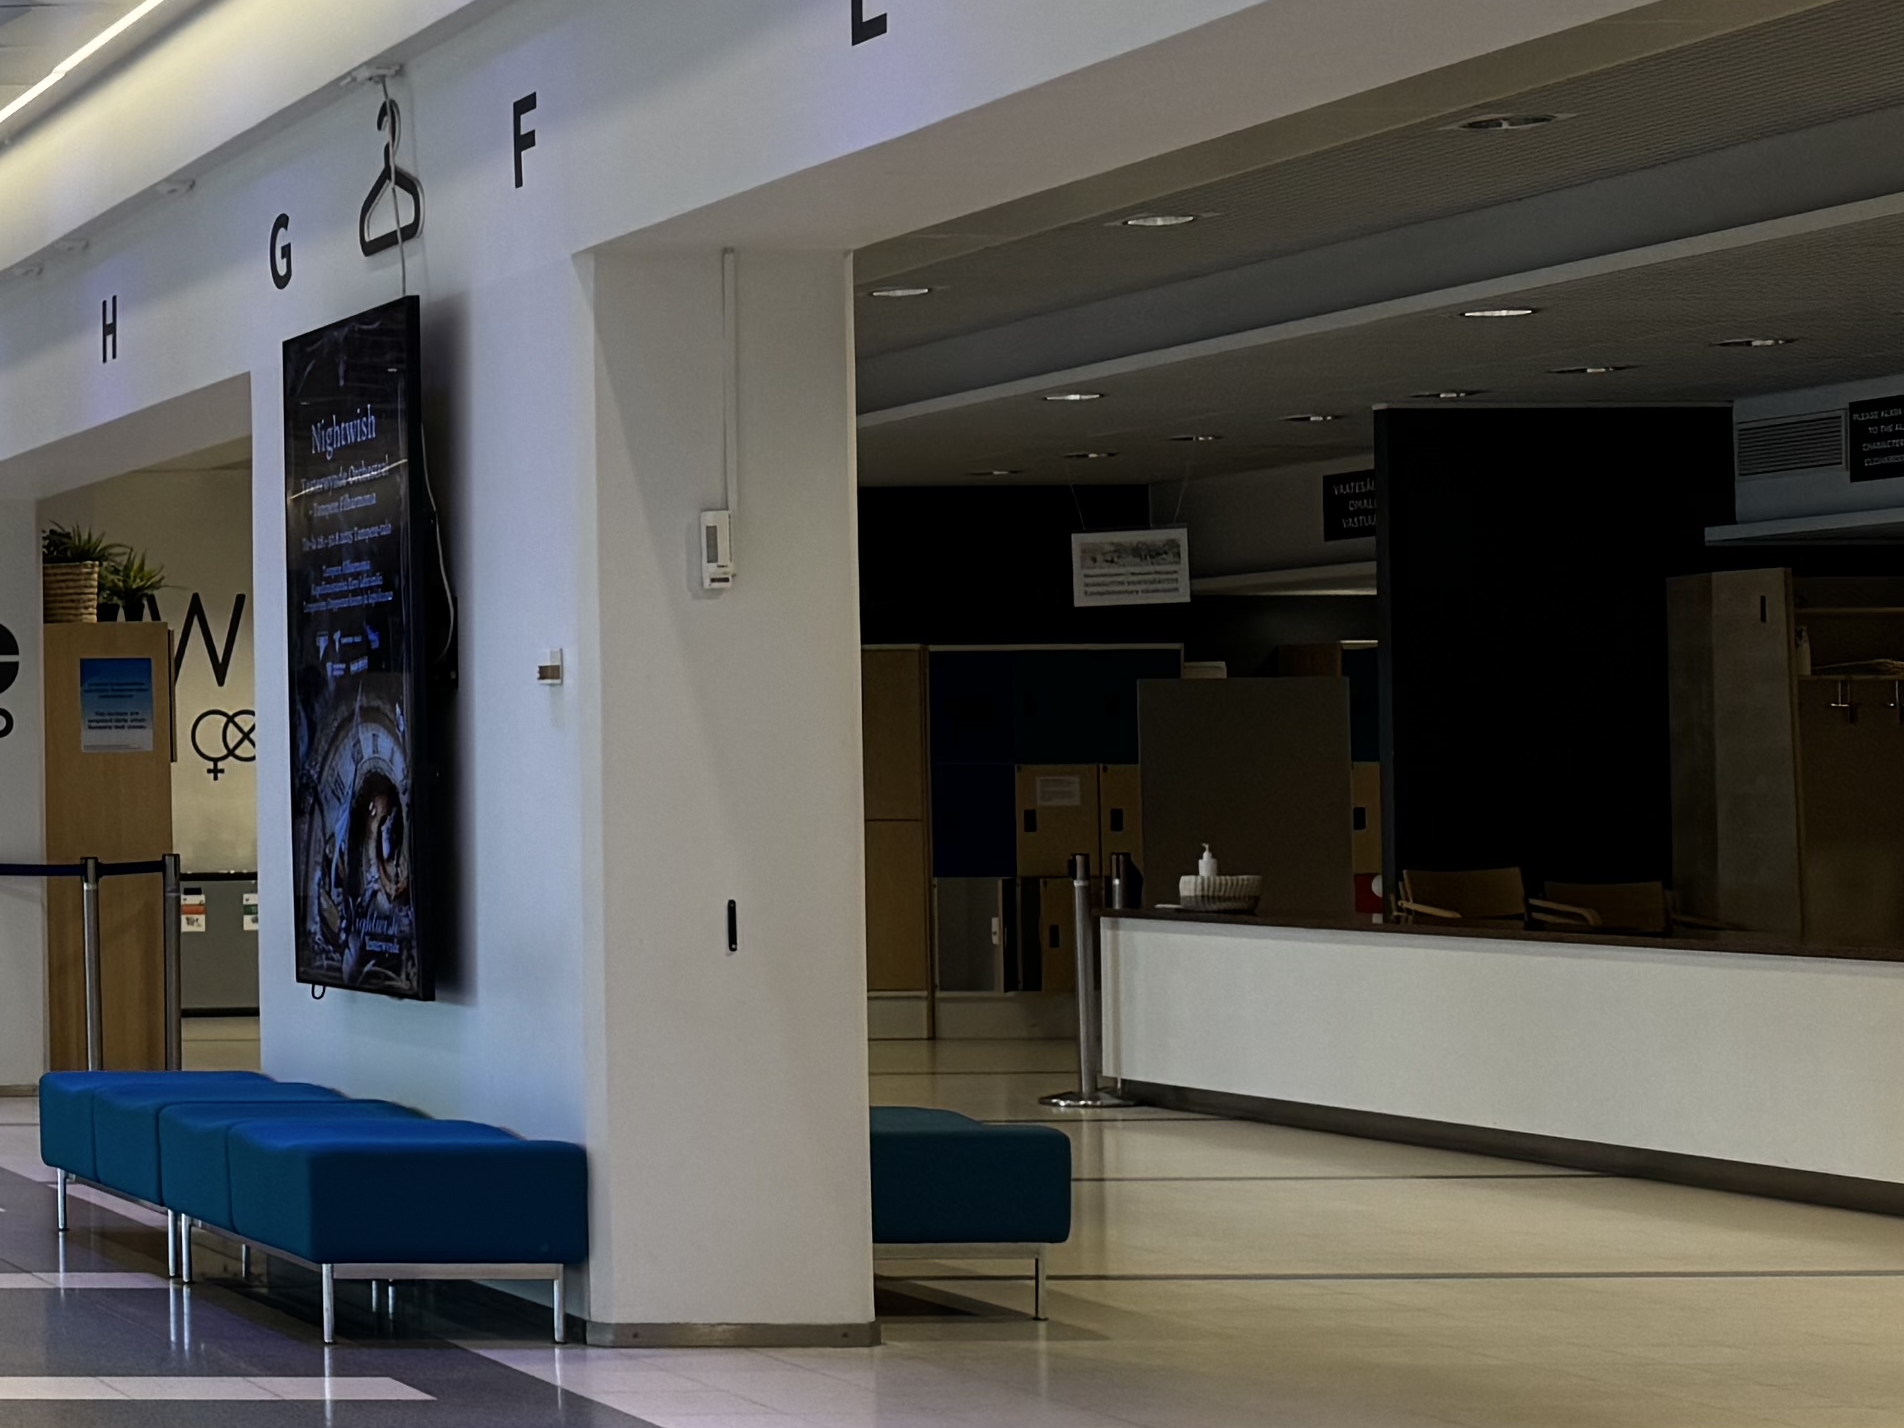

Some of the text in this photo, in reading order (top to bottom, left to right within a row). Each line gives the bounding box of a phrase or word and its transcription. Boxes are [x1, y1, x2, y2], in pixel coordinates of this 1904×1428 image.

[513, 92, 537, 188] F
[269, 212, 292, 290] G
[102, 294, 117, 363] H
[312, 404, 376, 460] Nightwish
